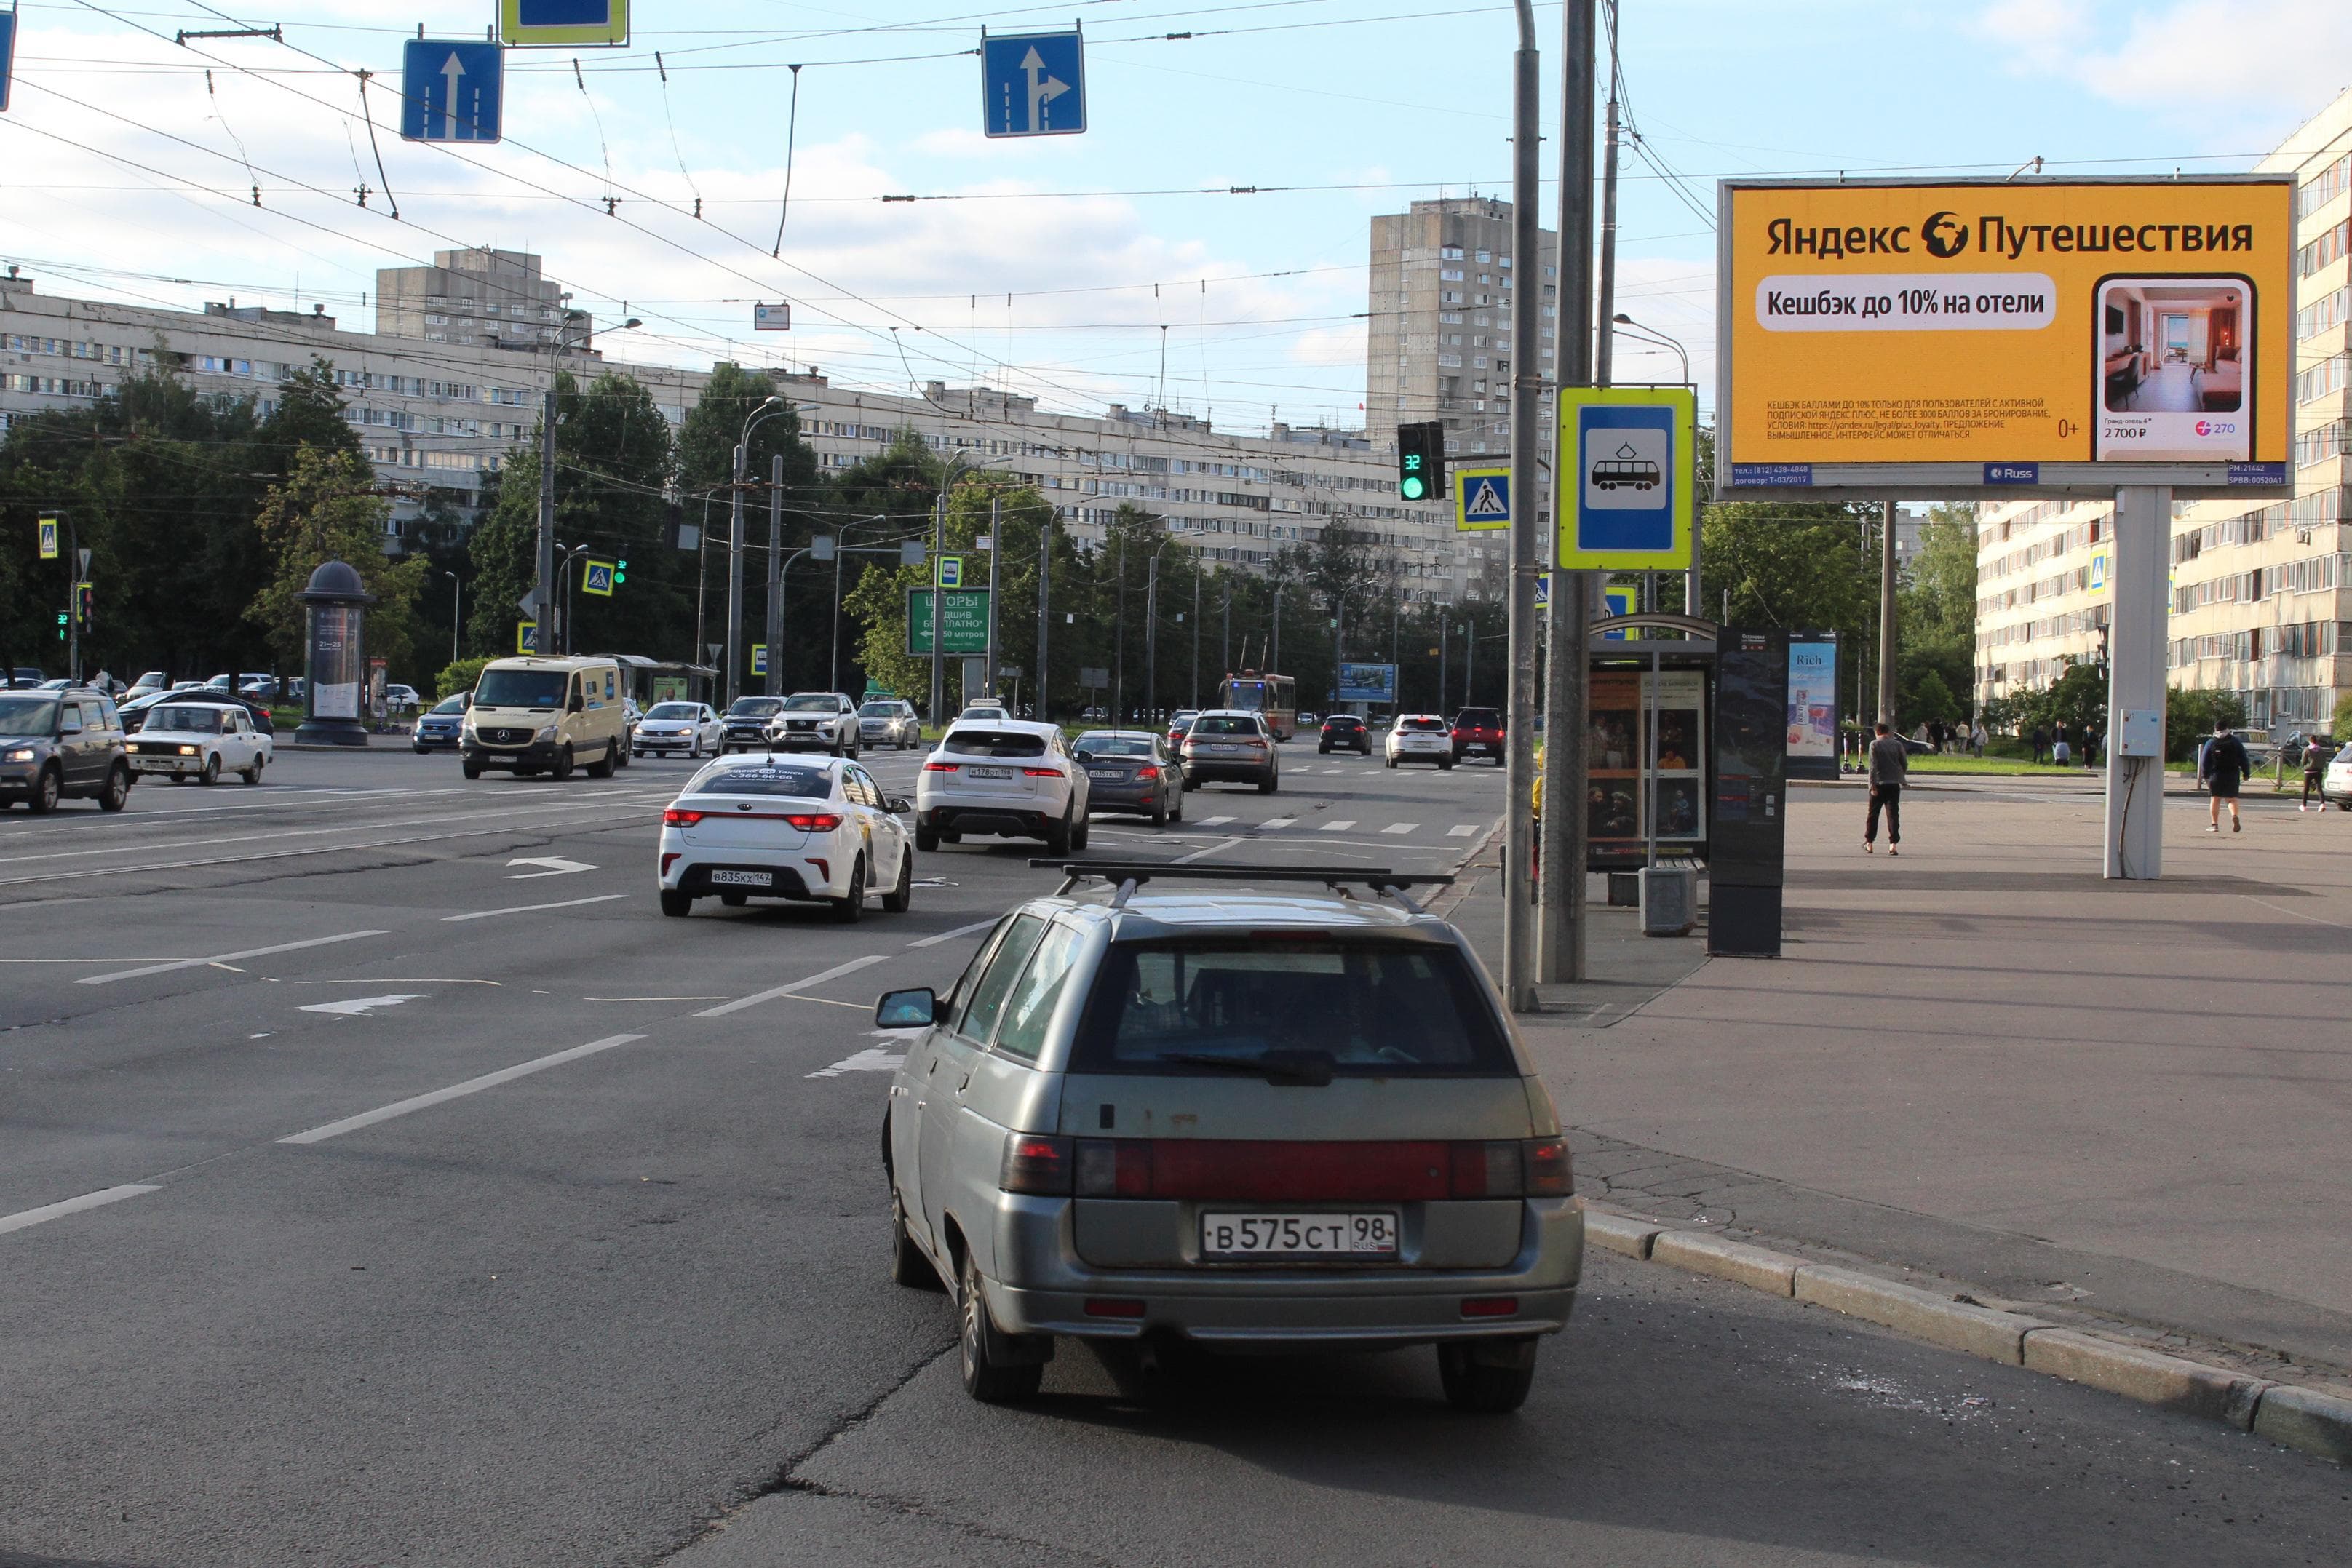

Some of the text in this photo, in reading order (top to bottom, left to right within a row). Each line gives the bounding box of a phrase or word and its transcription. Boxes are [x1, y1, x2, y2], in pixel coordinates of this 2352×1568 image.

[1767, 216, 2253, 260] Яндекс Путешествия
[1768, 290, 2045, 318] Кешбэк до 10% на отели
[1767, 397, 2043, 409] КЕШБЭК БАЛЛАМИ ДО 10% ТОЛЬКО ДЛЯ ПОЛЬЗОВАТЕЛЕЙ С АКТИВНОЙ
[1767, 409, 2051, 420] ПОДПИСКОЙ ЯНДЕКС ПЛЮС, НЕ БОЛЕЕ 3000 БАЛЛОВ ЗА БРОНИРОВАНИЕ,
[1767, 421, 1807, 430] УСЛОВИЯ:
[1944, 420, 2005, 429] ПРЕДЛОЖЕНИЕ
[2058, 418, 2079, 438] 0+
[2214, 423, 2236, 434] 270
[1767, 429, 1972, 440] ВЫМЫШЛЕННОЕ, ИНТЕРФЕЙС МОЖЕТ ОТЛИЧАТЬСЯ.
[1405, 455, 1420, 470] 32
[1754, 466, 1772, 474] (812)
[2004, 468, 2033, 479] Russ
[926, 596, 978, 607] ШОРЫ
[931, 611, 972, 620] ДШИВ
[923, 620, 983, 628] БЕПЛАТНО
[1797, 655, 1821, 665] Rich
[715, 872, 769, 883] В835КХ 147
[1217, 1217, 1386, 1250] В575СТ 98
[1354, 1241, 1375, 1250] RUS
